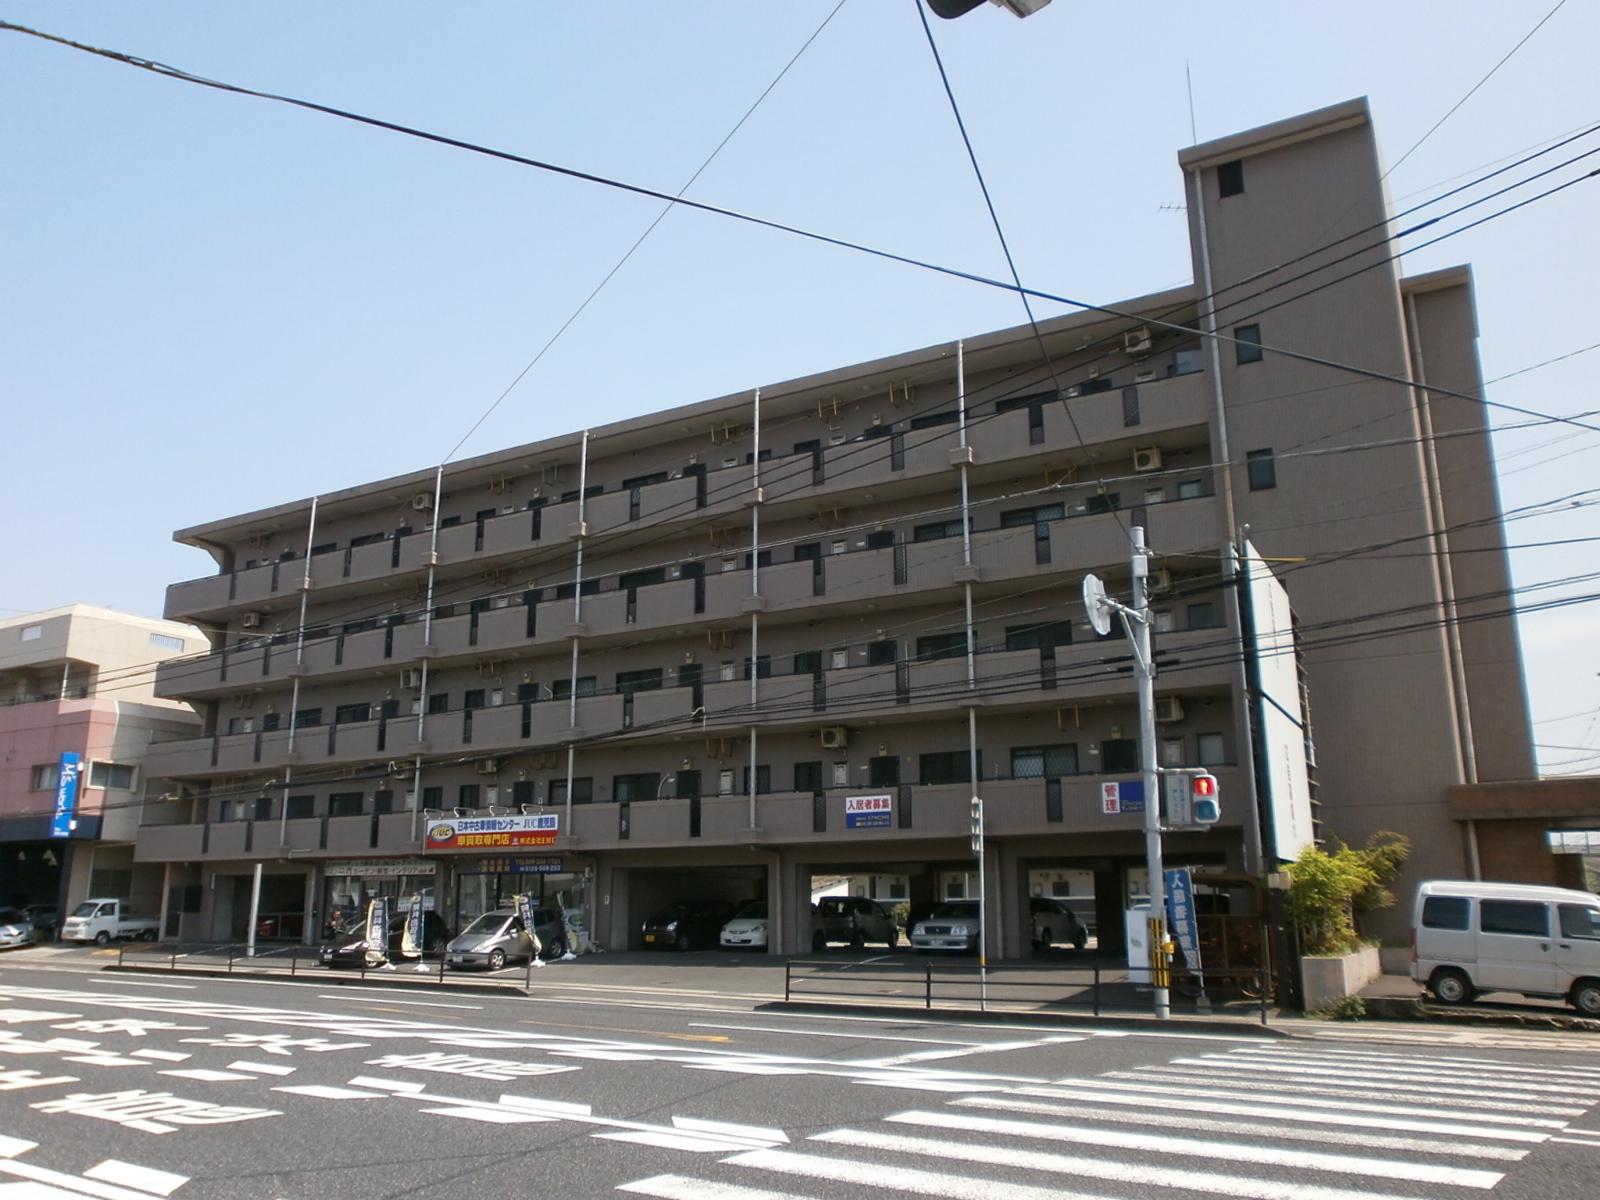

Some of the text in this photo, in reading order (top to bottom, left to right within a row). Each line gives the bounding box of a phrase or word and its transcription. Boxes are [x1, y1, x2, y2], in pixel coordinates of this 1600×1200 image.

[848, 798, 889, 811] 入居者募集
[1104, 784, 1118, 811] 管理
